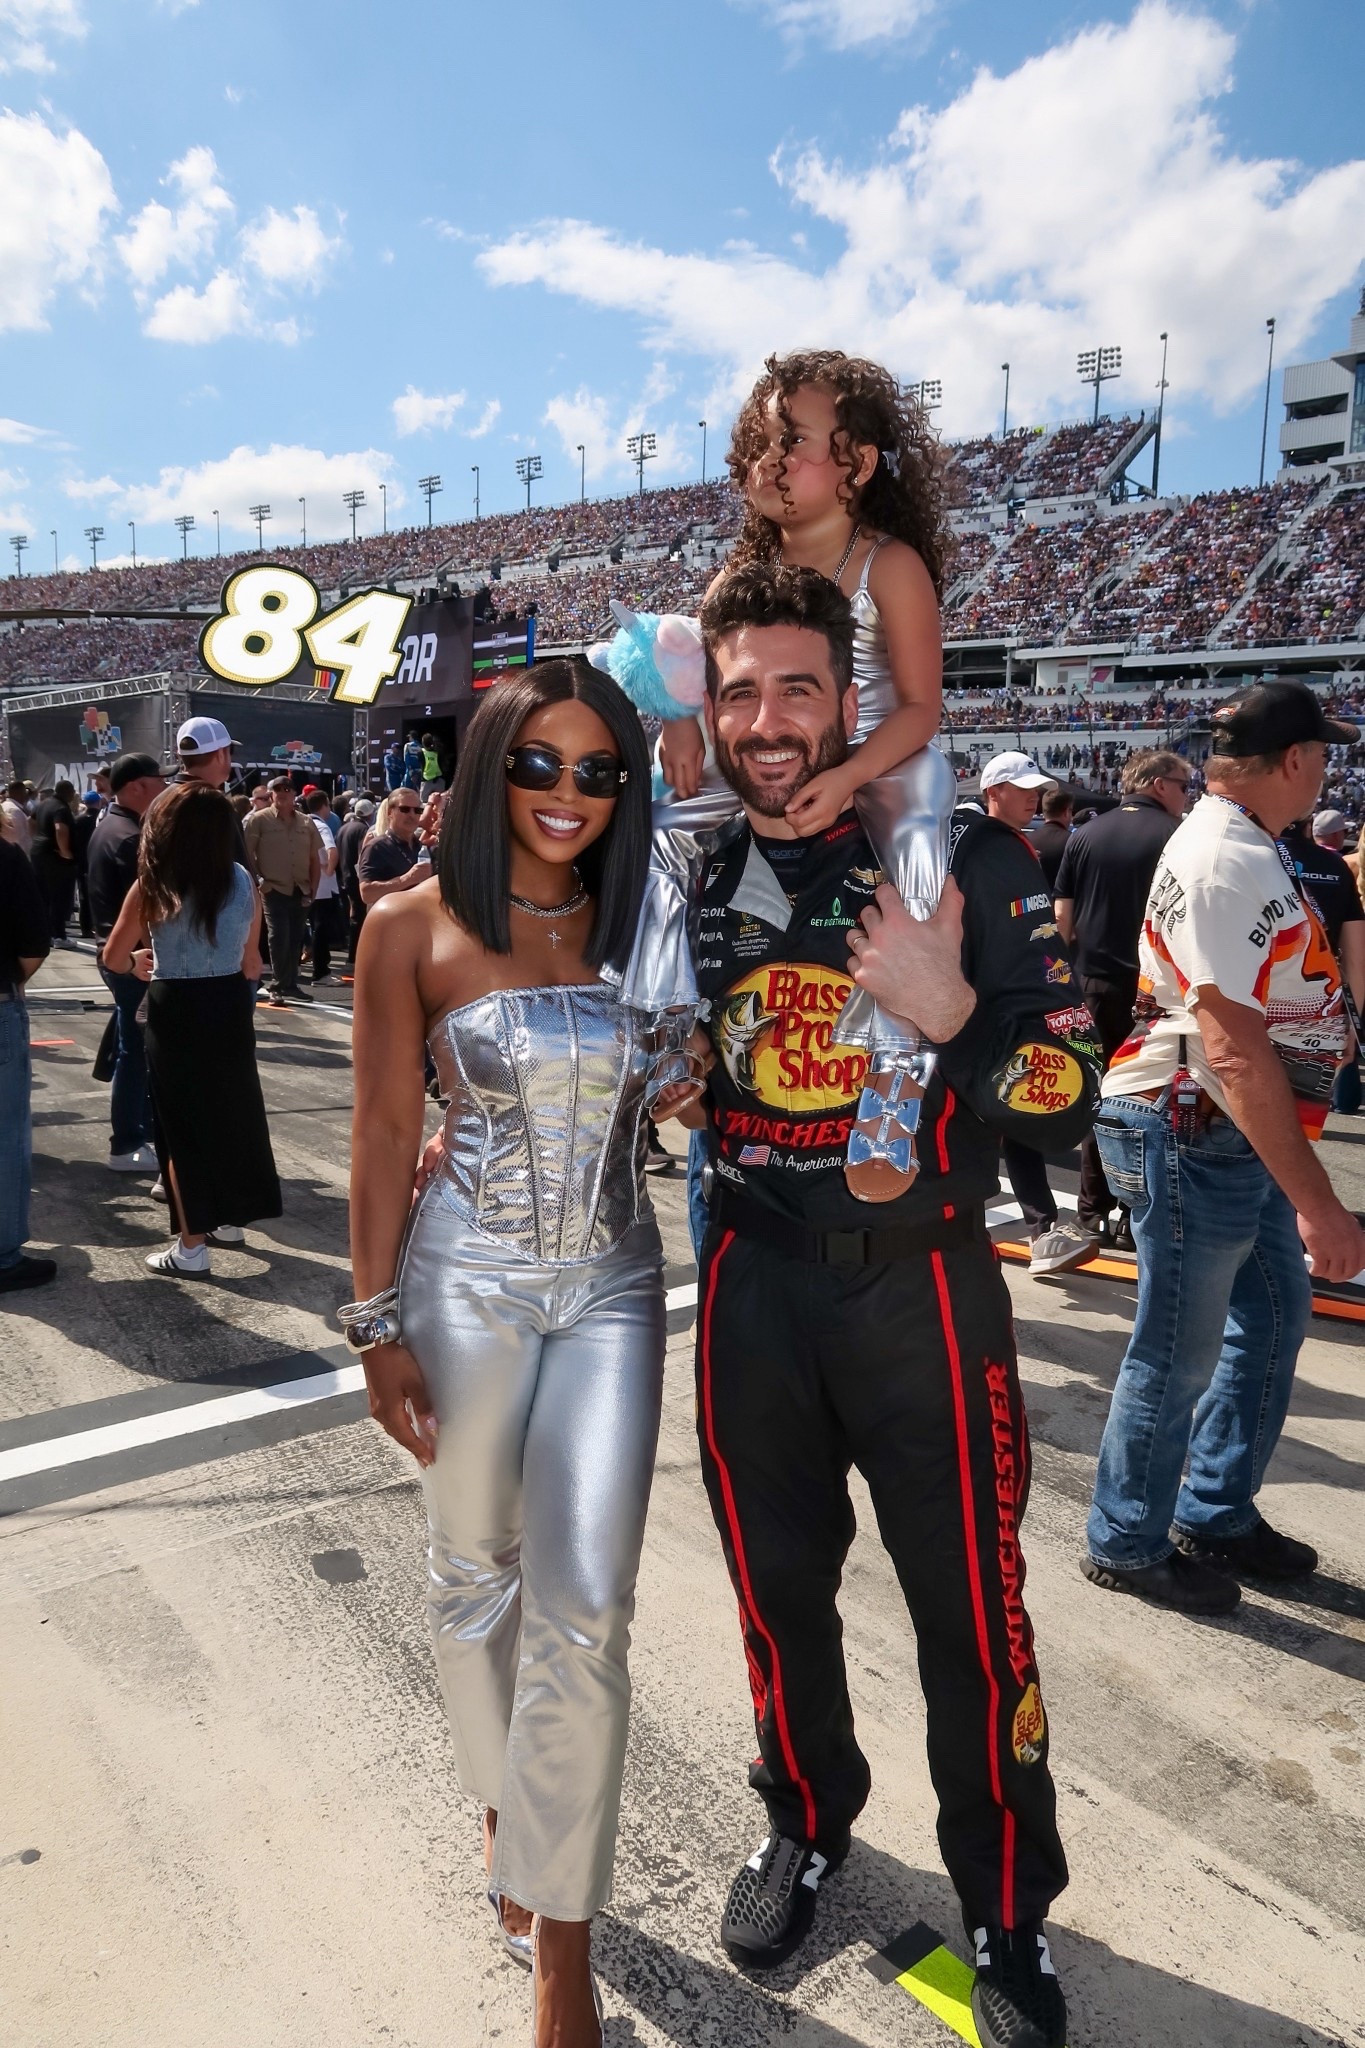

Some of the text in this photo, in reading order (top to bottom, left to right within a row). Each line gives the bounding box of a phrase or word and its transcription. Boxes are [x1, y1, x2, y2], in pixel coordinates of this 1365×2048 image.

[199, 564, 413, 704] 84
[386, 632, 438, 685] AR
[425, 706, 432, 715] 2
[1276, 844, 1297, 877] NASCAR
[811, 918, 823, 927] GET
[764, 969, 852, 1012] Bass
[769, 1010, 835, 1051] Pro
[1049, 1013, 1074, 1028] TOYS
[1289, 1032, 1331, 1040] BLEND
[1301, 1038, 1321, 1047] 40
[1028, 1045, 1066, 1069] Bass
[778, 1048, 871, 1097] Shop
[1028, 1066, 1058, 1088] Pro
[1019, 1085, 1071, 1111] Shops
[770, 1150, 784, 1167] The
[985, 1362, 1031, 1688] WINCHESTER
[1015, 1710, 1026, 1747] Bass
